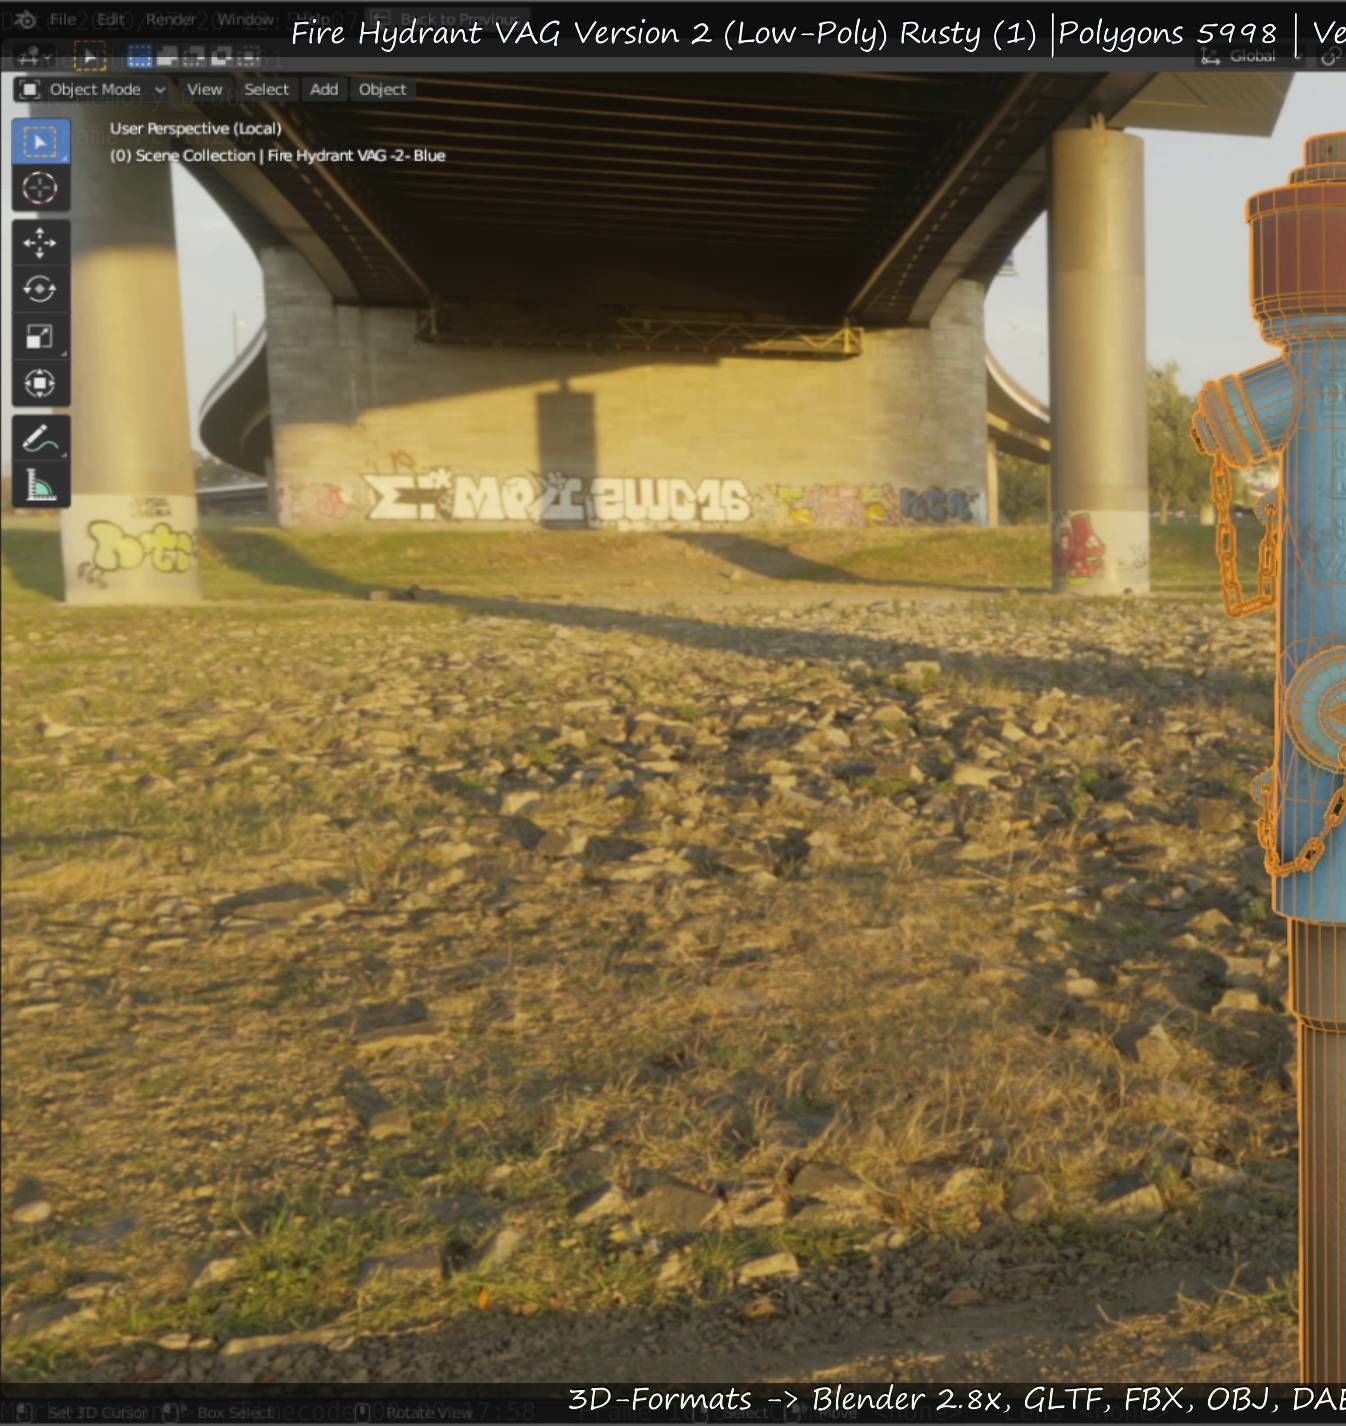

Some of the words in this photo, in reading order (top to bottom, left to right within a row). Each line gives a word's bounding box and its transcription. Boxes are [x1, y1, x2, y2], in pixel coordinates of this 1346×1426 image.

[51, 13, 76, 26] File
[146, 13, 197, 26] Render
[218, 13, 275, 26] Window
[1230, 50, 1276, 63] Global
[50, 84, 99, 99] Object
[102, 84, 141, 97] Mode
[187, 84, 222, 97] View
[244, 84, 289, 97] Select
[310, 84, 338, 97] Add
[359, 84, 407, 99] Object
[110, 122, 142, 136] User
[147, 122, 229, 139] Perspective
[233, 122, 281, 138] (Local)
[110, 149, 131, 164] (0)
[136, 149, 180, 163] Scene
[183, 149, 256, 163] Collection
[268, 149, 293, 163] Fire
[296, 149, 354, 167] Hydrant
[358, 150, 387, 163] VAG
[413, 149, 446, 163] Blue
